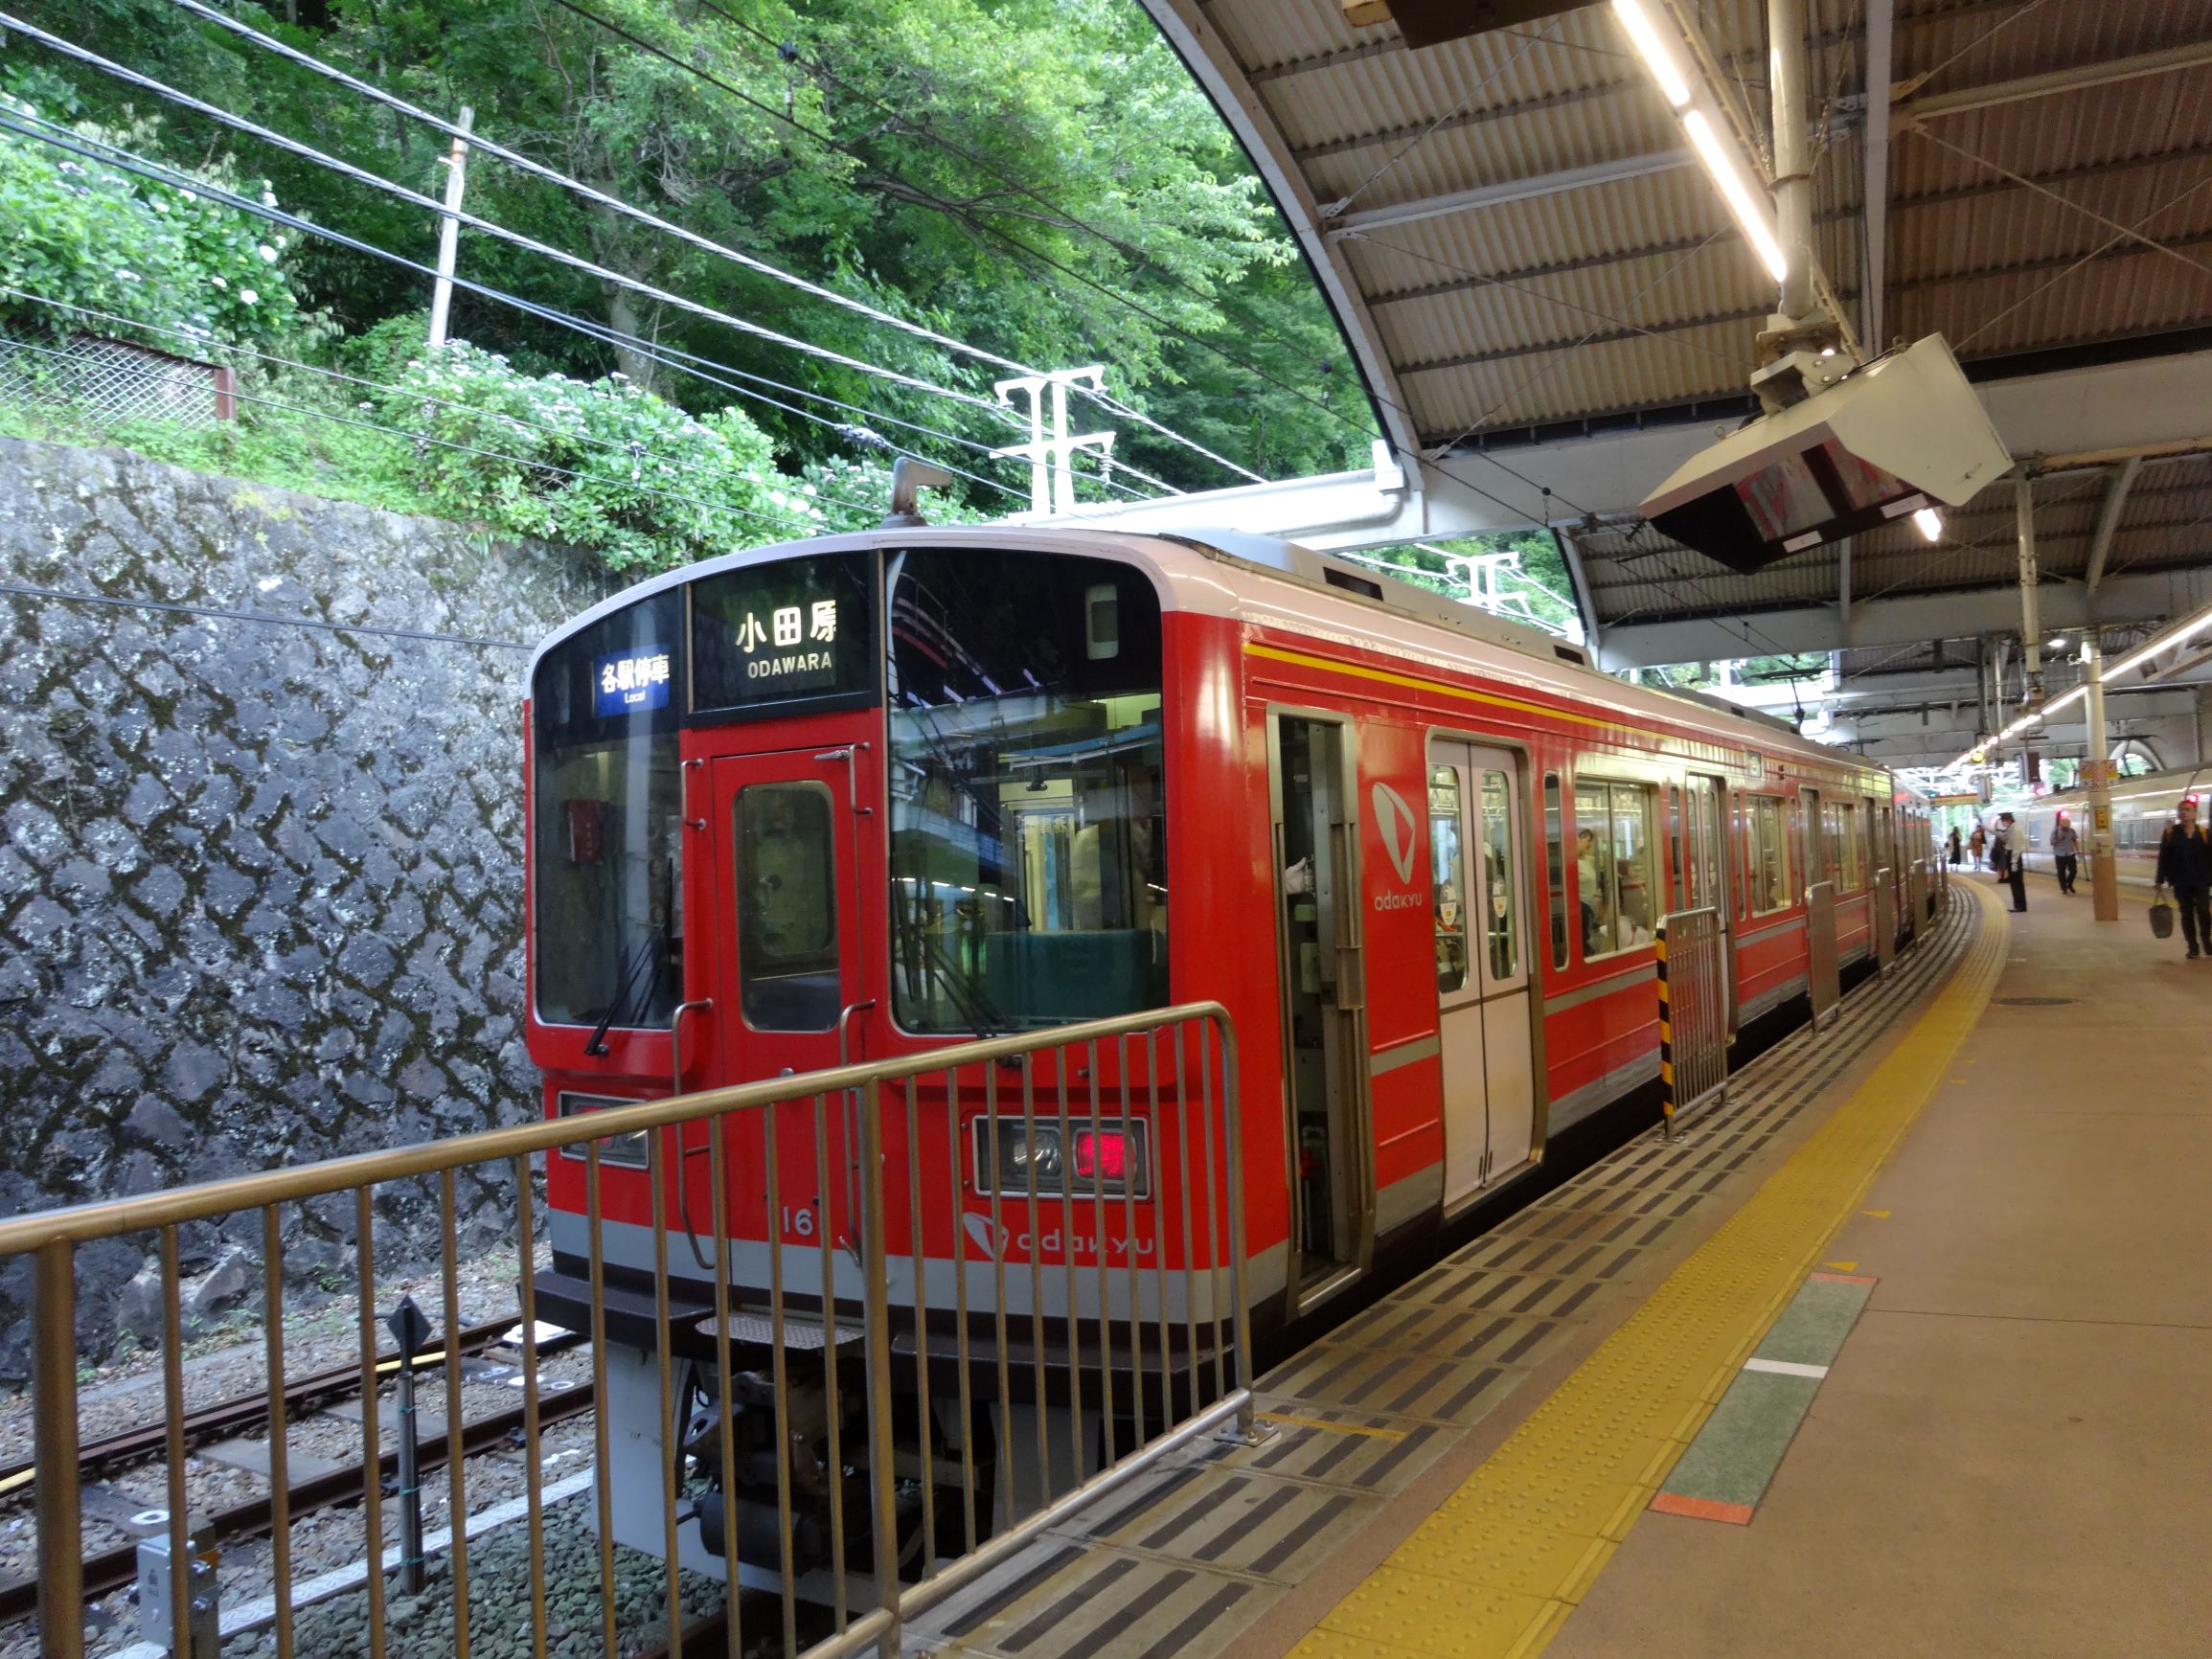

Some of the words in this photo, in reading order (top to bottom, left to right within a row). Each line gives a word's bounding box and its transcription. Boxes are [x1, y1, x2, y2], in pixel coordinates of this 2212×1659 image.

[735, 600, 836, 653] 小田原
[601, 654, 670, 693] 各駅停車
[748, 651, 832, 678] ODAWARA
[624, 690, 646, 703] Local
[1374, 889, 1423, 911] odakyu
